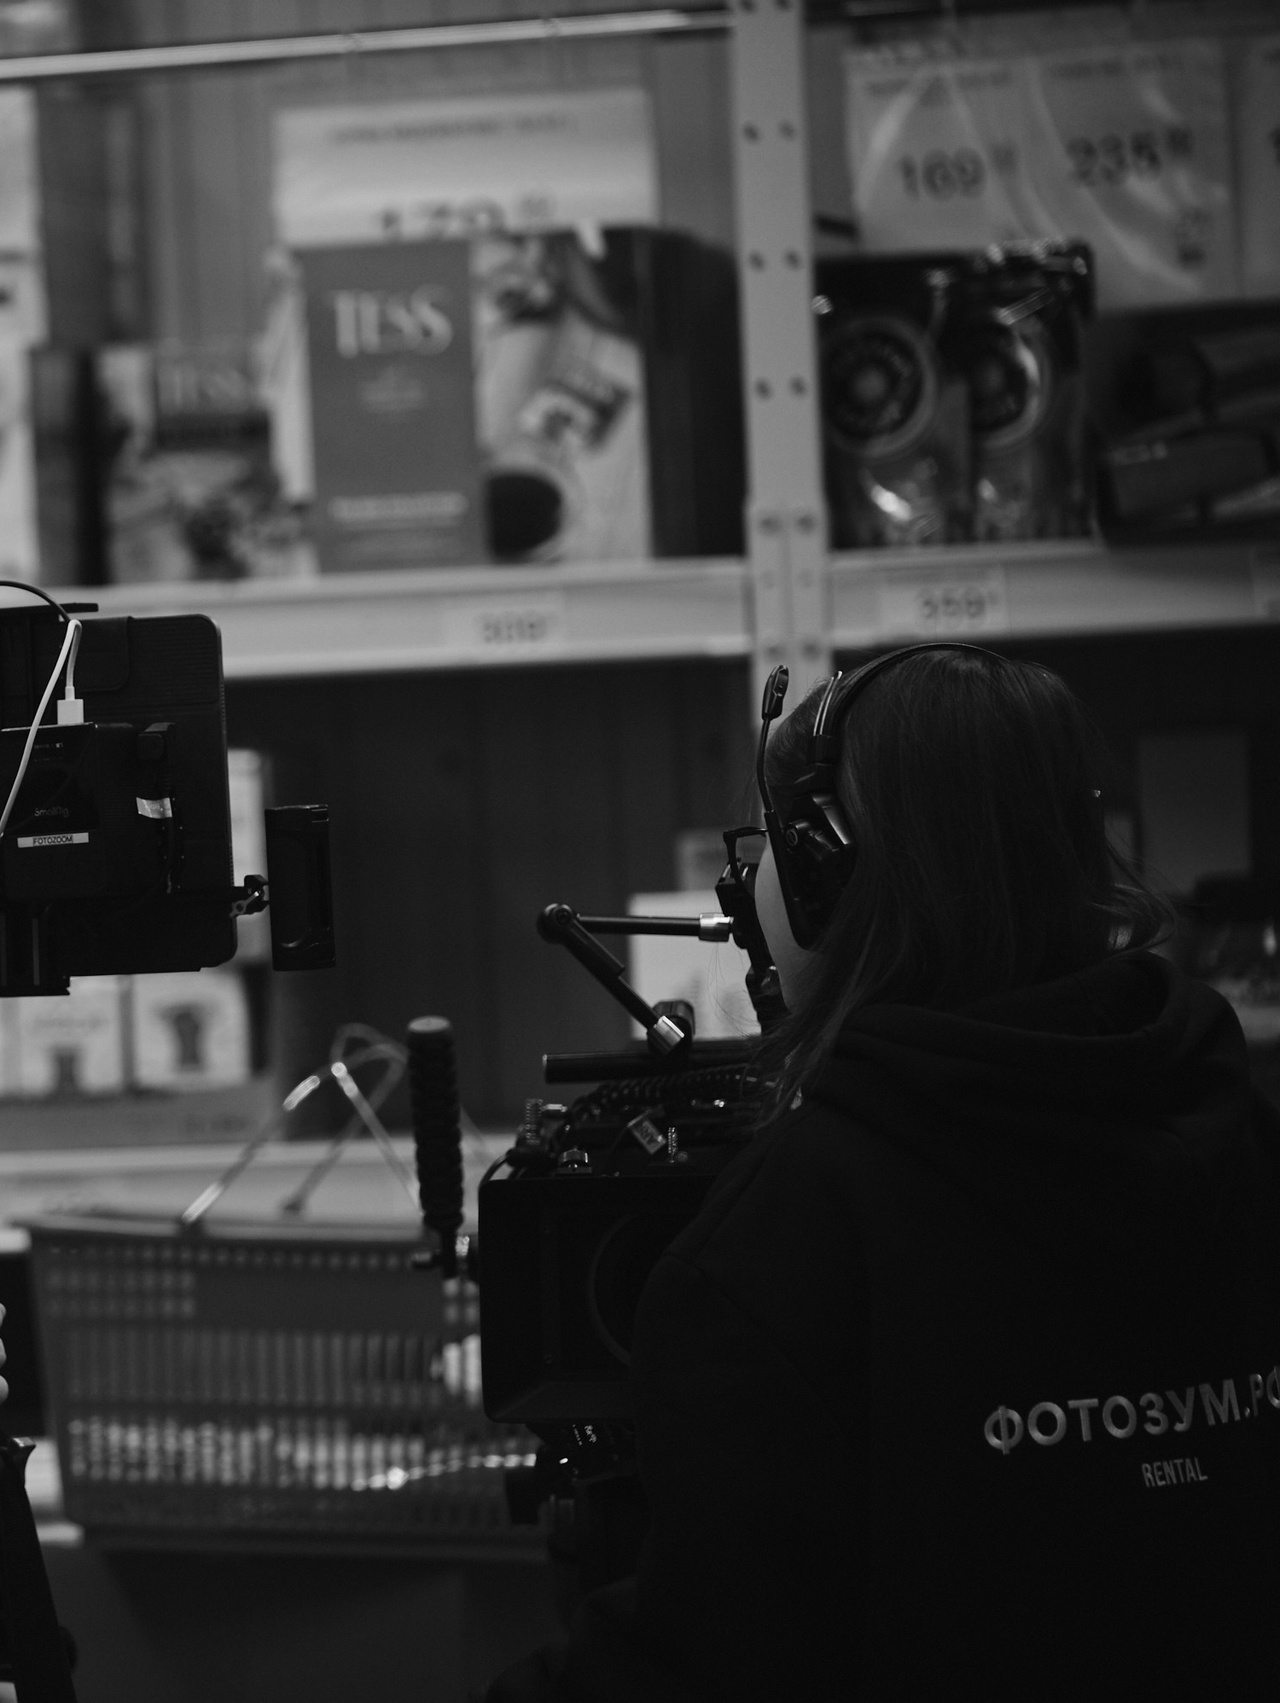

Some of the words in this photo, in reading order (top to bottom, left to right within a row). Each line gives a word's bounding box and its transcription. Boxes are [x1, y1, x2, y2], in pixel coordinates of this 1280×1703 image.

[326, 283, 455, 359] TESS
[33, 834, 73, 846] FOTOZOOM
[1141, 1456, 1209, 1488] RENTAL
